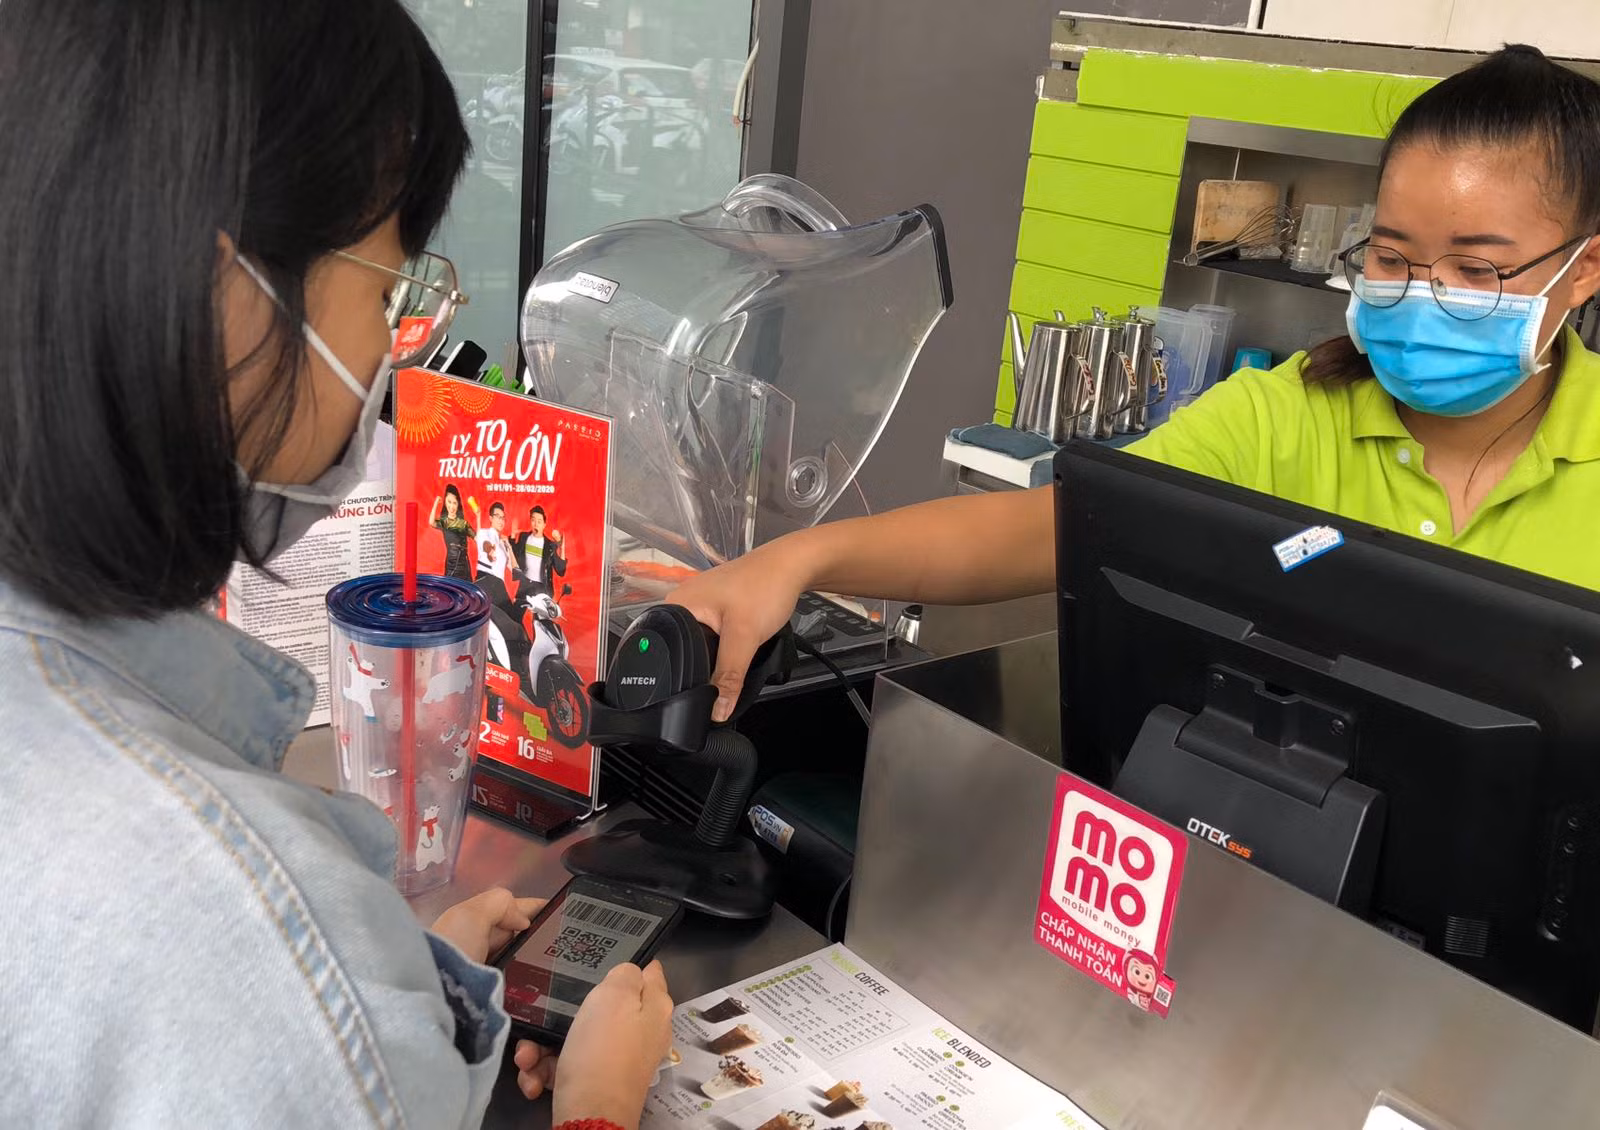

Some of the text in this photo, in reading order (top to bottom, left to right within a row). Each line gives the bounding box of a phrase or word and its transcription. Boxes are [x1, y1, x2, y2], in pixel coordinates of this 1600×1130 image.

[439, 423, 563, 482] TRÚNG LỚN
[450, 419, 508, 455] LY TO
[347, 496, 378, 505] CHƯƠNG
[367, 502, 393, 516] LỚN
[620, 676, 656, 685] ANTECH
[517, 735, 535, 760] 16
[1061, 895, 1142, 948] mobile money
[1040, 911, 1117, 966] CHẤP NHẬN
[1038, 926, 1123, 988] THANH TOÁN
[855, 972, 890, 997] COFFEE
[947, 1038, 992, 1069] BLENDED
